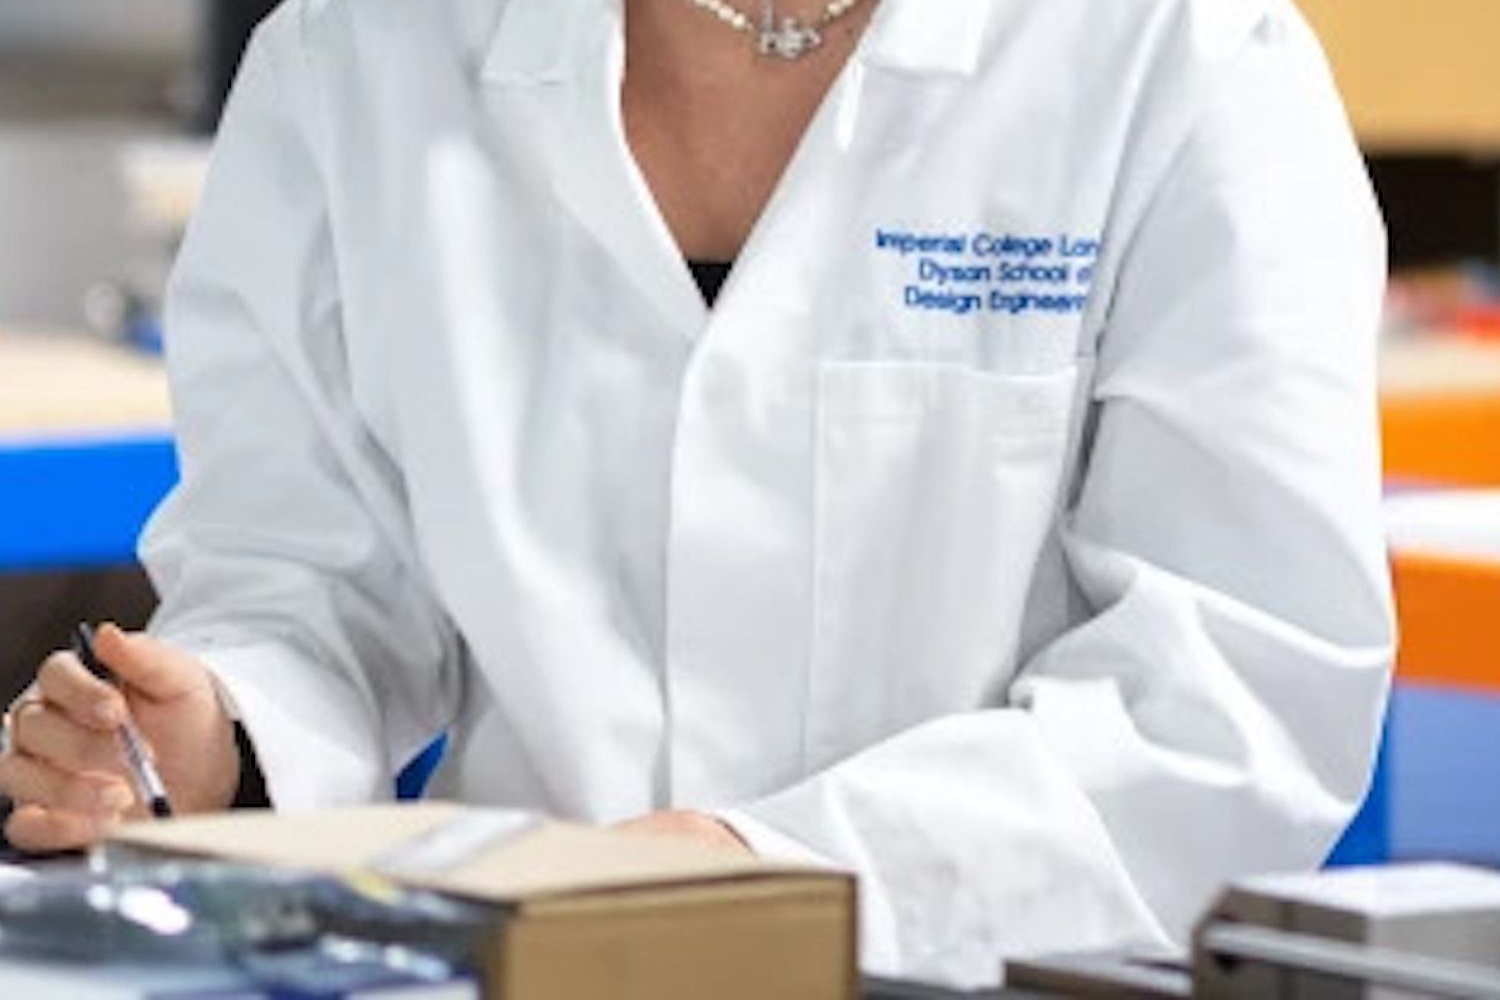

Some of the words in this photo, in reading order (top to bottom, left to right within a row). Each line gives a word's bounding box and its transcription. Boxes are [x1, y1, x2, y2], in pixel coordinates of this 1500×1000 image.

[876, 229, 965, 257] Imperial
[972, 233, 1052, 258] College
[1059, 235, 1101, 257] Lon
[919, 258, 990, 285] Dyson
[998, 262, 1068, 283] School
[904, 286, 981, 314] Design
